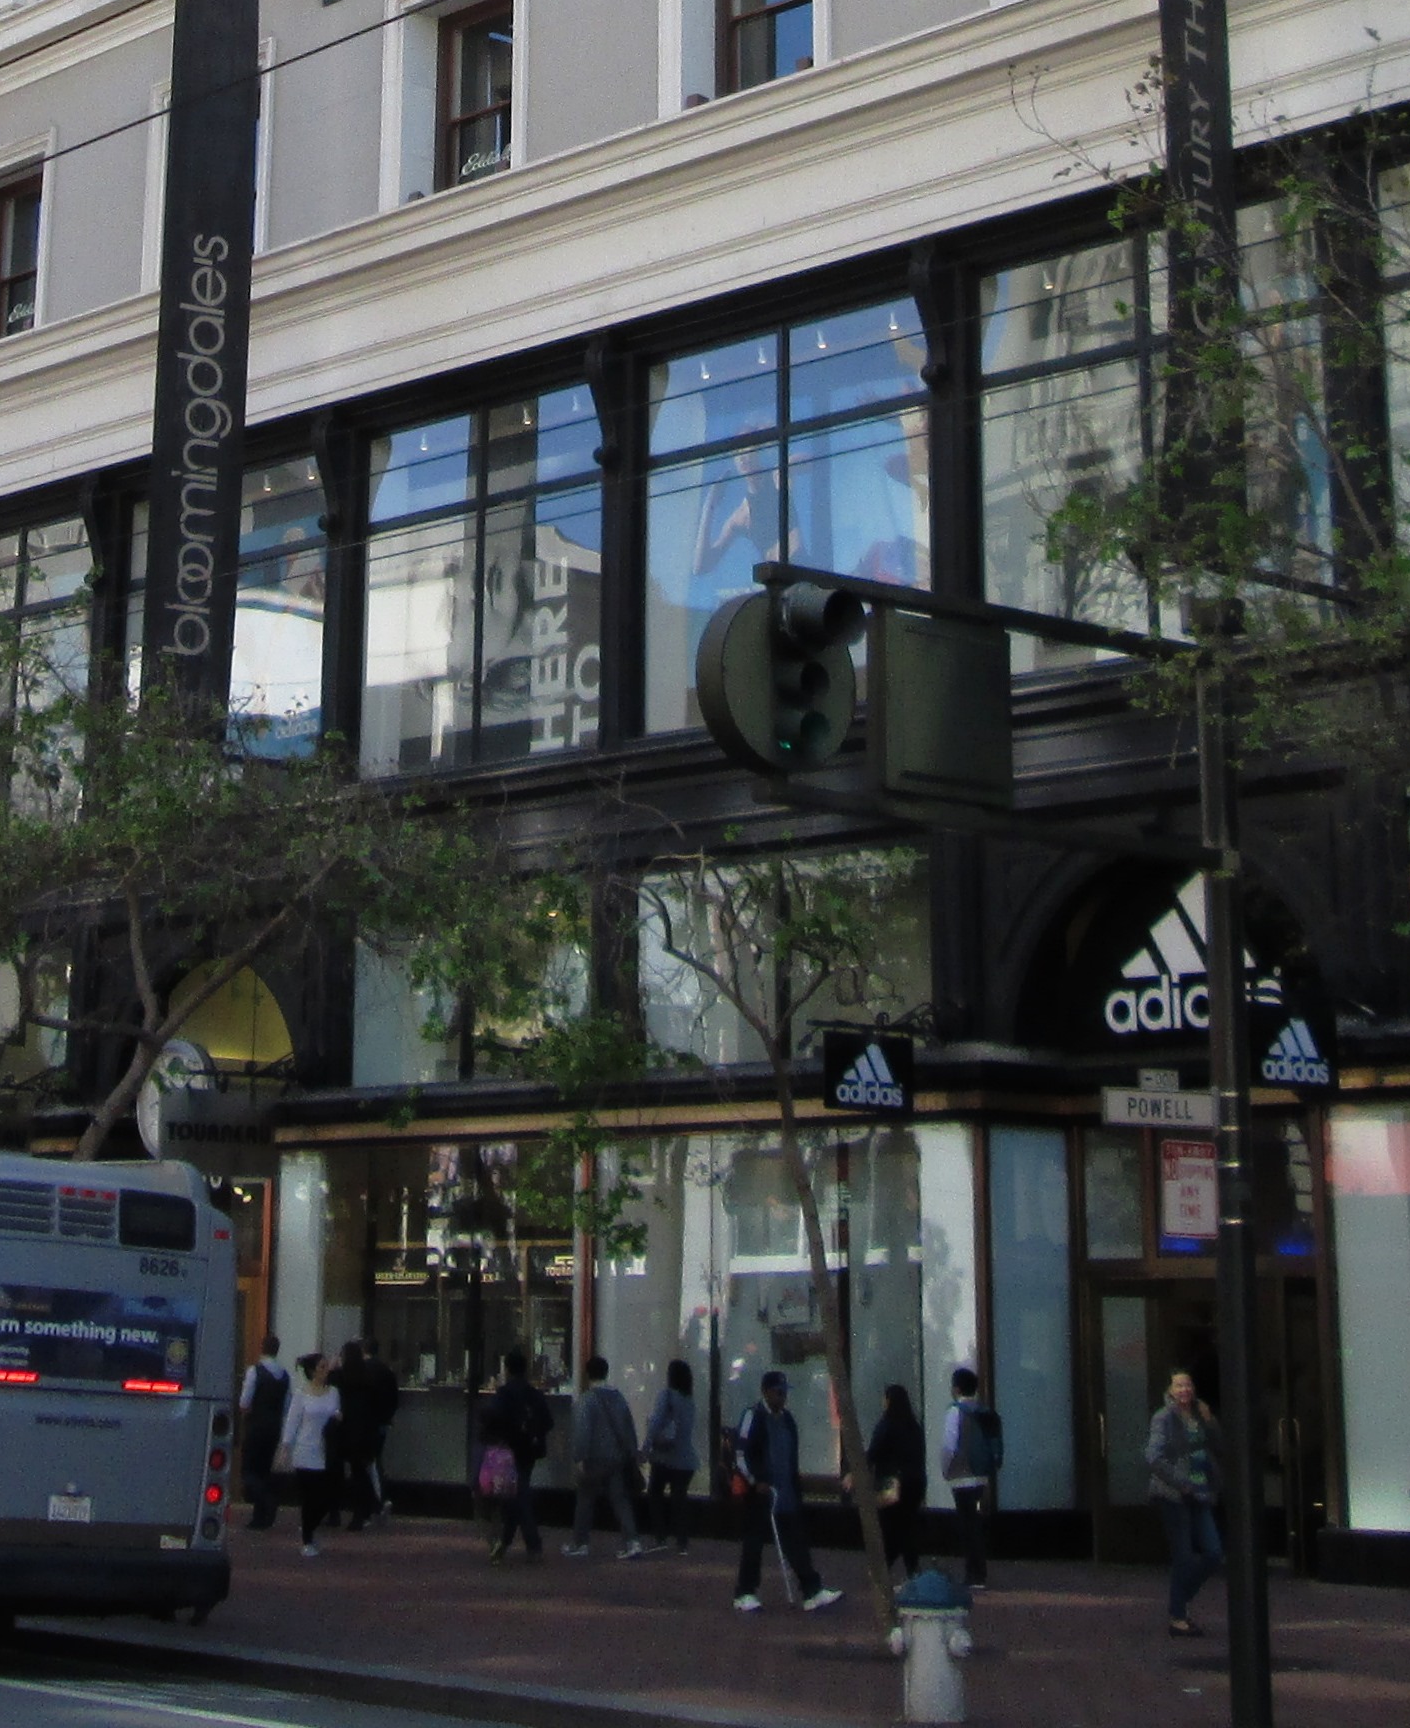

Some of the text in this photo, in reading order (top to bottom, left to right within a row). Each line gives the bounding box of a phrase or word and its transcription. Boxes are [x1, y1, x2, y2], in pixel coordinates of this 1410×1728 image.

[529, 557, 568, 753] HERE
[1261, 1056, 1330, 1085] adidas
[836, 1080, 903, 1107] adidas
[1127, 1096, 1194, 1120] POWELL
[140, 1256, 180, 1276] 8626
[24, 1319, 116, 1345] something
[120, 1326, 159, 1344] new.
